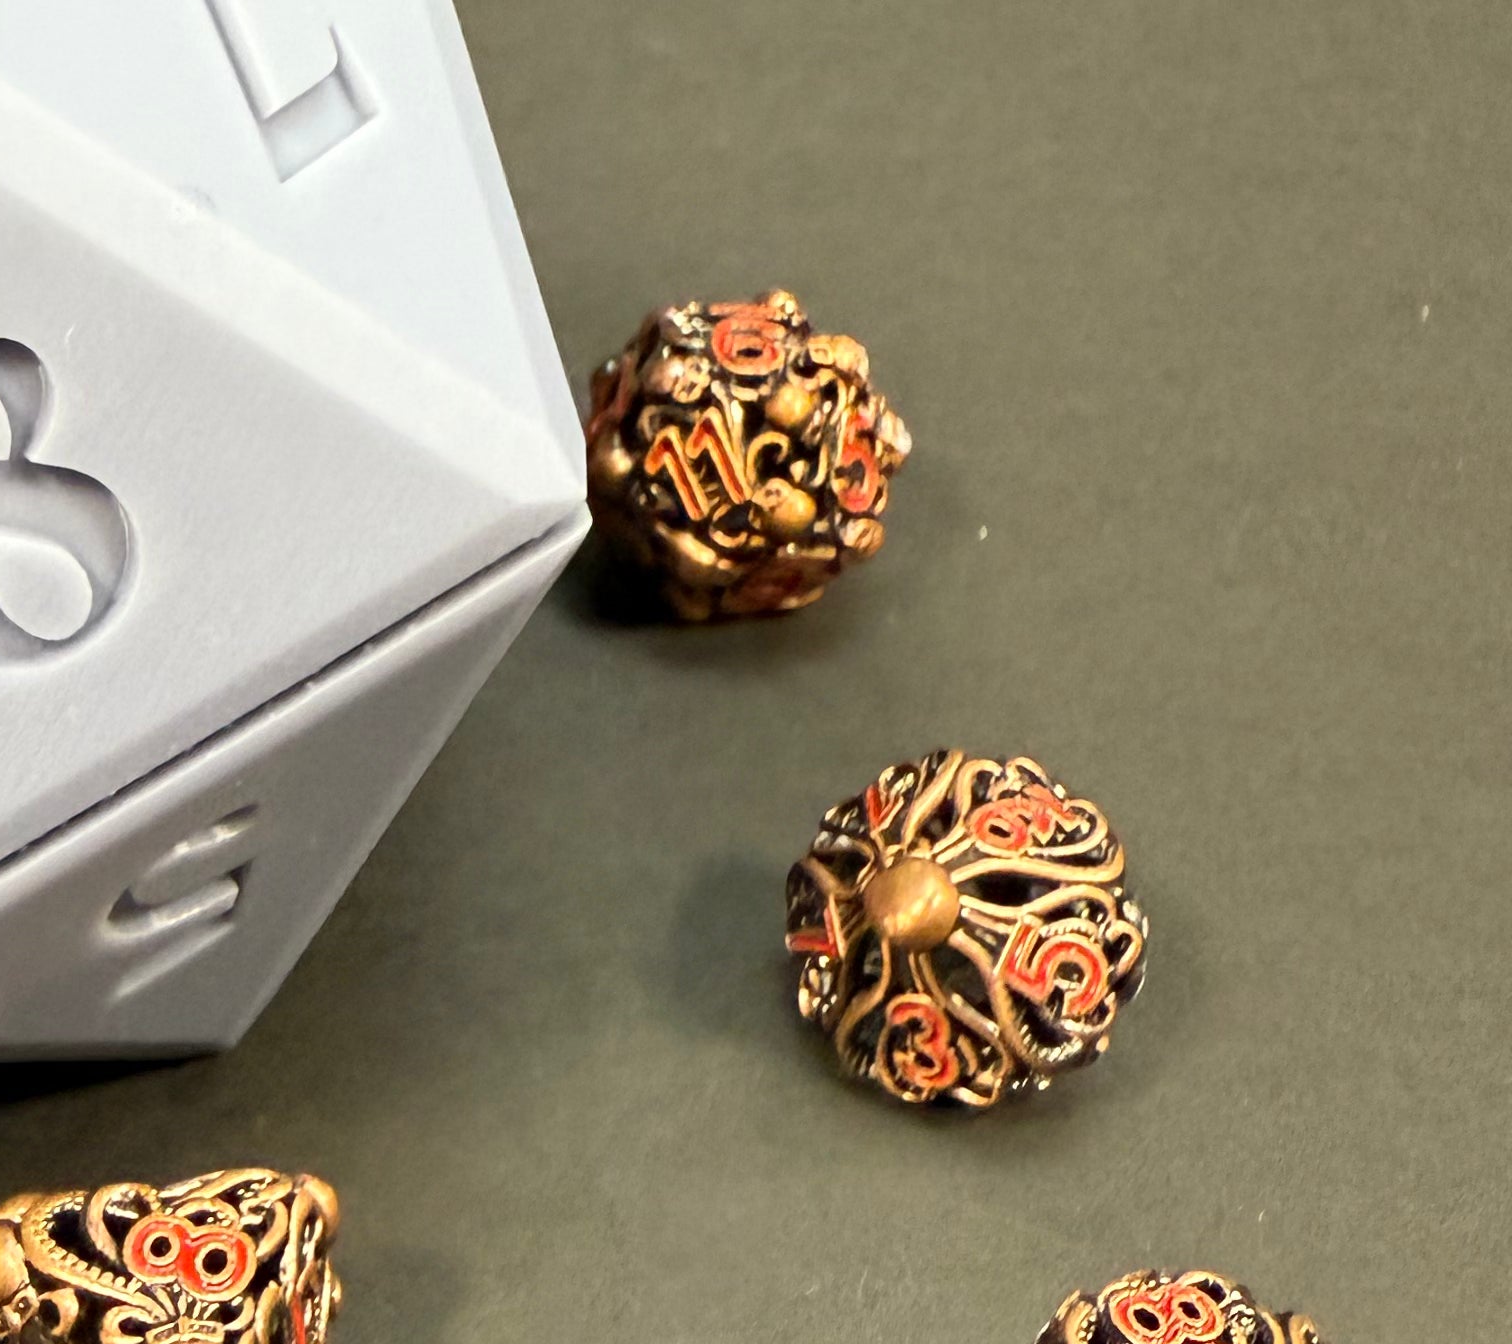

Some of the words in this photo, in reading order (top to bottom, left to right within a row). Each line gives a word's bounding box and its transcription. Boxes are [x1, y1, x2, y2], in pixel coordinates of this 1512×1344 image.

[1001, 920, 1108, 1018] 5
[886, 996, 962, 1092] 3
[124, 1214, 258, 1302] 8
